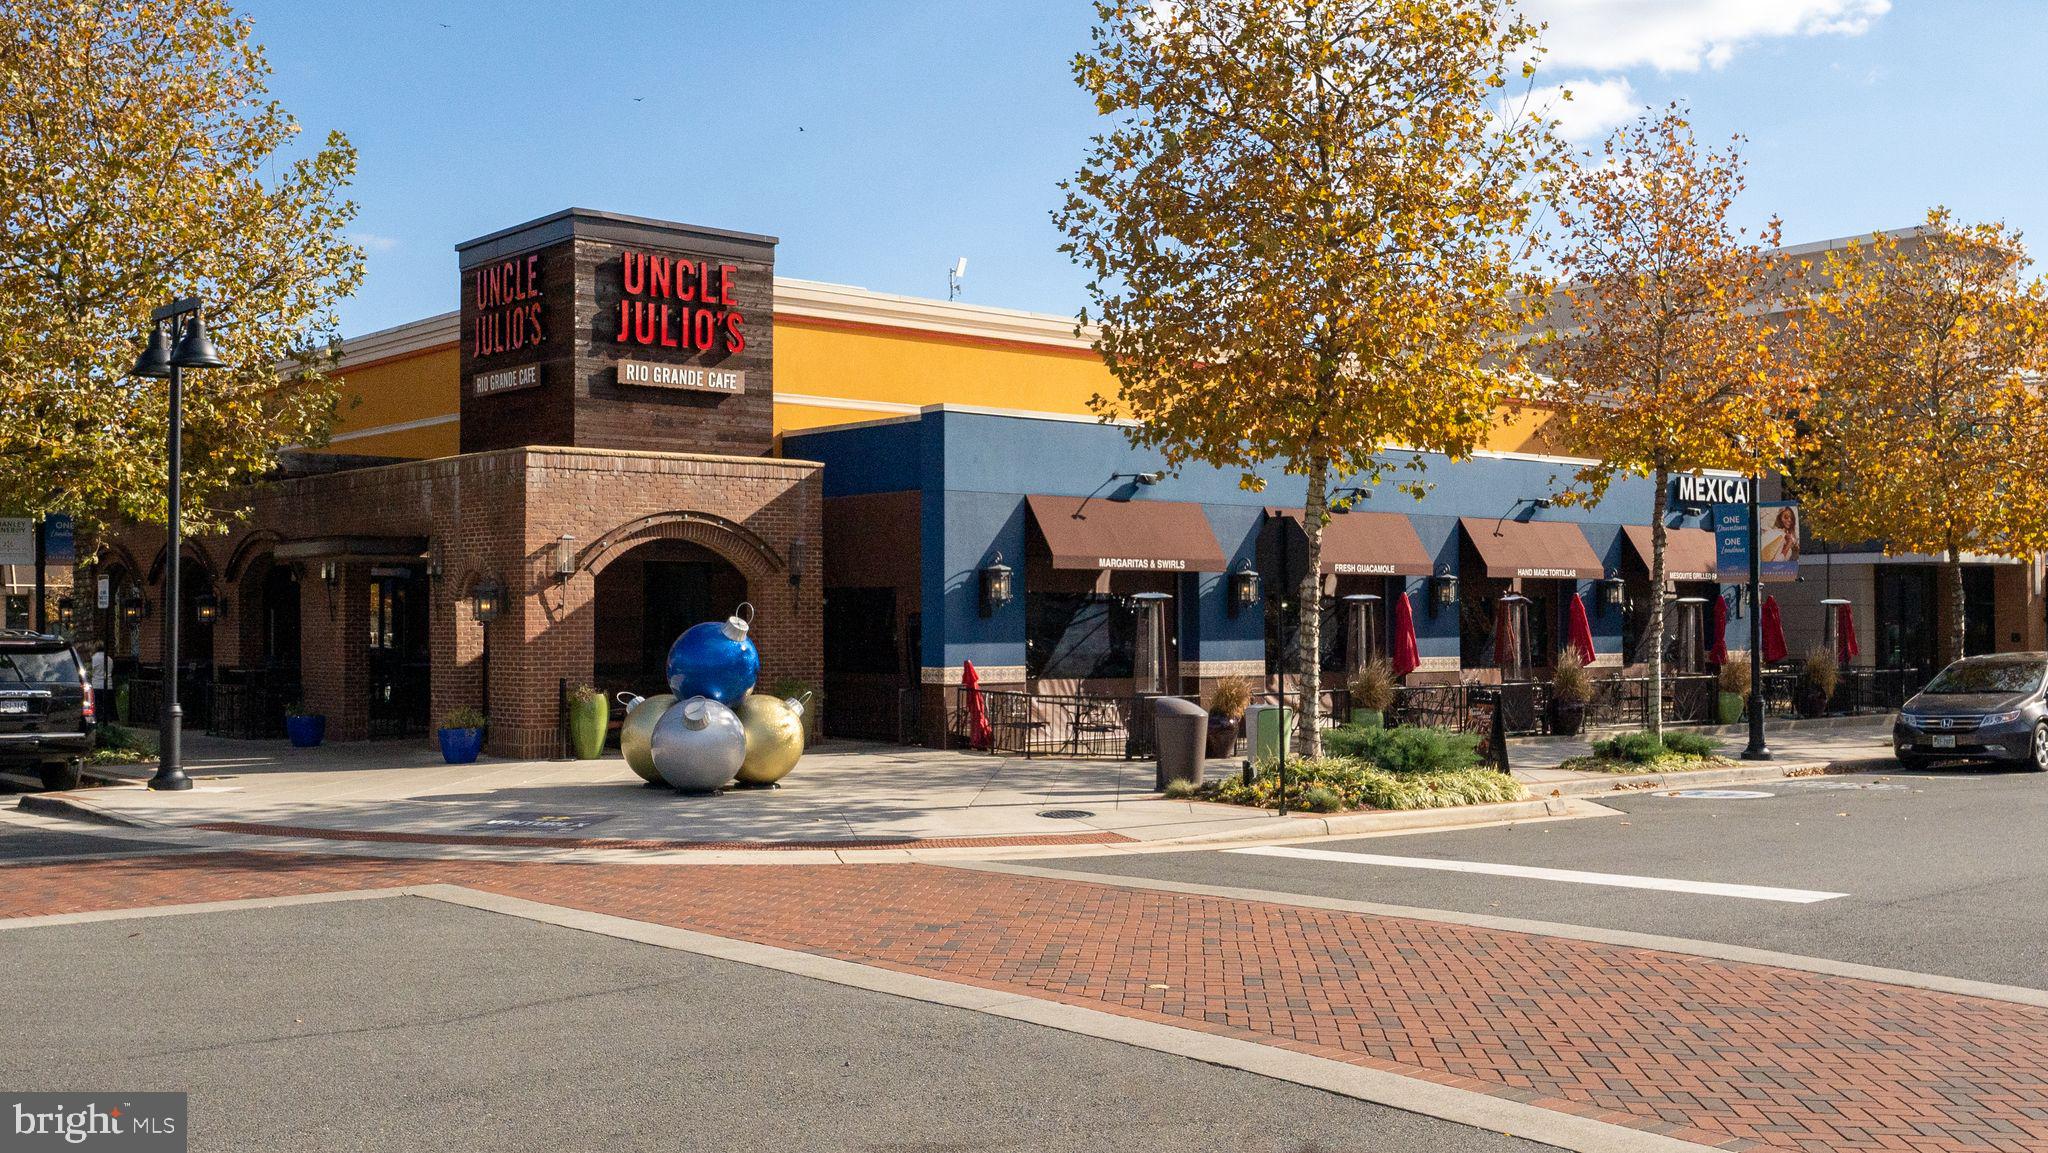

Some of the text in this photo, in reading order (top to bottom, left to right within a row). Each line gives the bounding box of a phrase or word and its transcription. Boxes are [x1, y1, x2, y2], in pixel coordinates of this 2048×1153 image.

[476, 255, 539, 311] UNCLE
[624, 251, 738, 306] UNCLE
[473, 302, 542, 359] JULIO'S
[617, 299, 746, 353] JULIO'S
[476, 367, 536, 393] RIO GRANDE CAFE
[626, 364, 737, 389] RIO GRANDE CAFE
[1723, 515, 1740, 524] ONE
[1724, 537, 1741, 546] ONE
[1099, 558, 1185, 569] MARGARITAS & SWIRLS
[1334, 563, 1395, 574] FRESH GUACAMOLE
[1517, 568, 1533, 576] HAND
[1549, 569, 1576, 577] TORTILLAS
[1692, 572, 1711, 580] GRILLED
